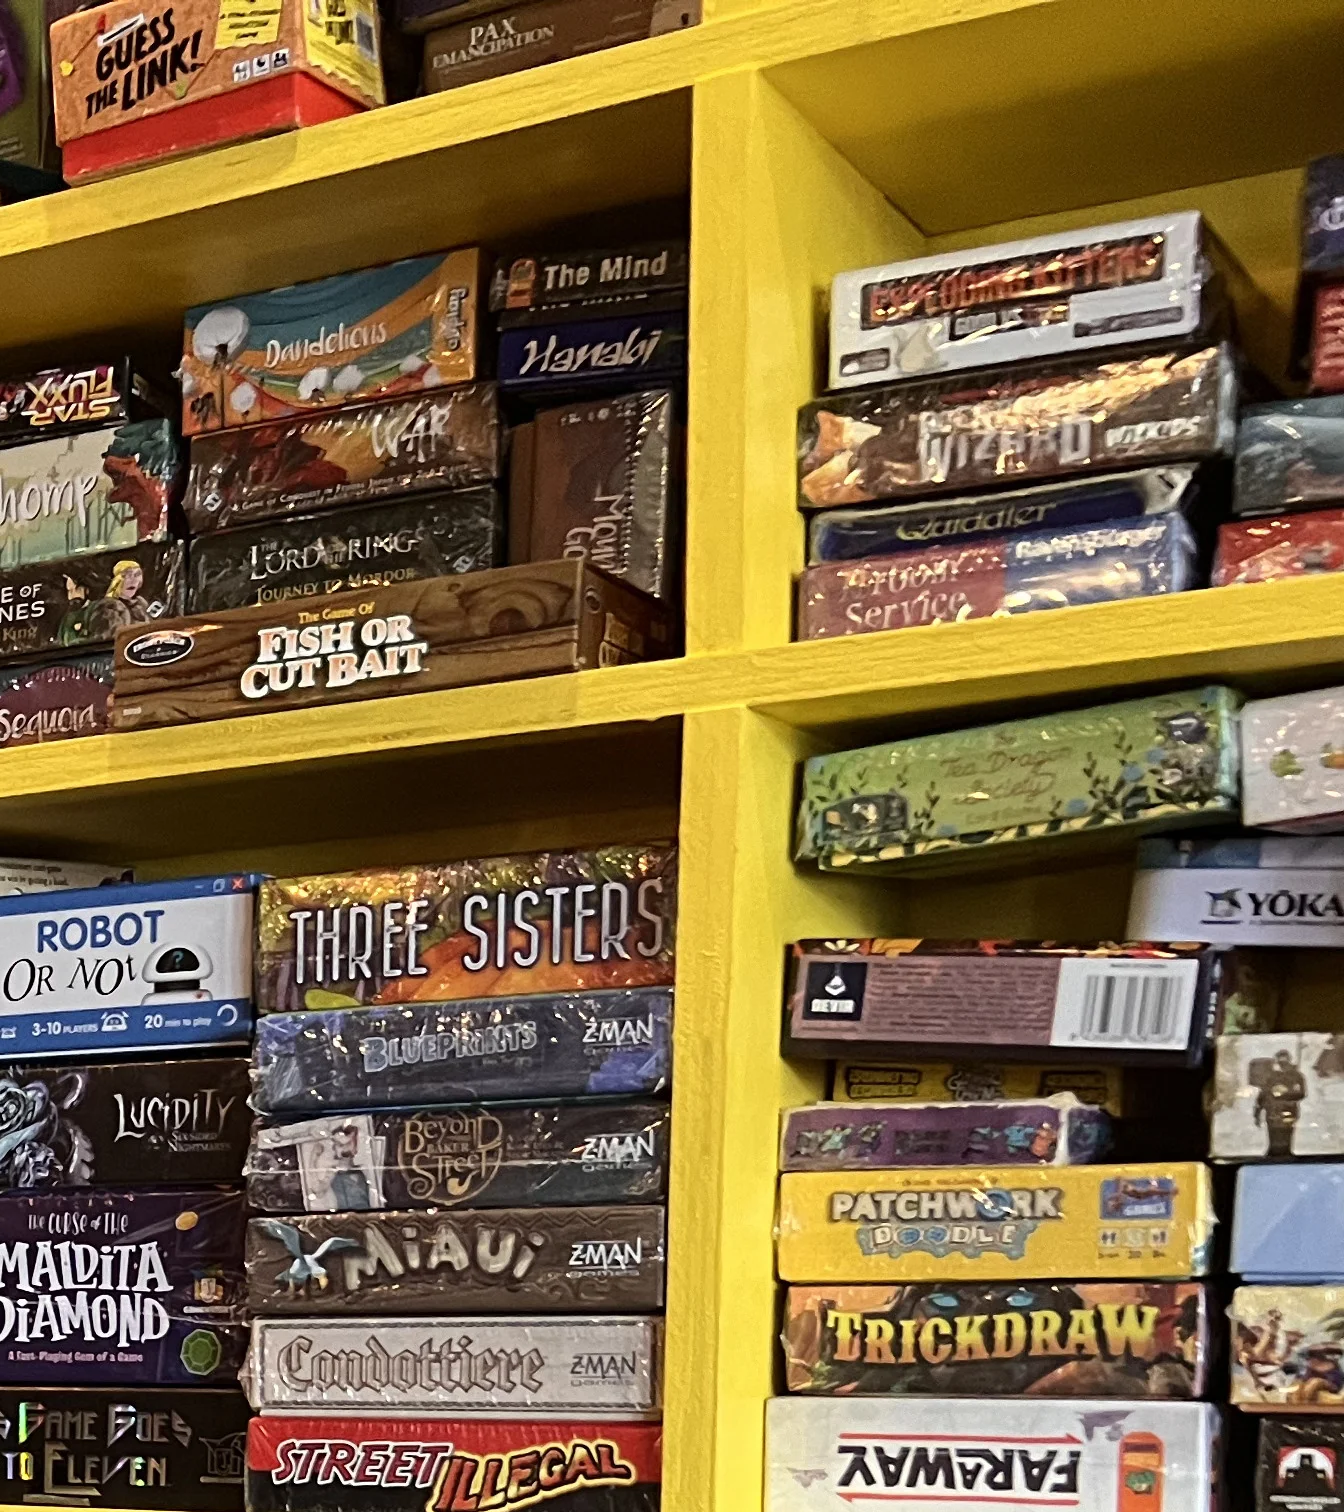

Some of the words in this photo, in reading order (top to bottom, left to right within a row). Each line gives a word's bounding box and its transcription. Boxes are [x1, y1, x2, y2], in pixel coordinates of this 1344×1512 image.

[95, 8, 176, 81] GUESS
[470, 18, 516, 46] PAX
[86, 83, 117, 119] THE
[120, 31, 205, 110] LINK!
[545, 263, 590, 291] The
[599, 250, 666, 283] Mind
[519, 327, 663, 376] Hanabi
[18, 582, 41, 599] OF
[255, 619, 353, 663] FISH
[360, 614, 414, 646] OR
[240, 650, 320, 700] CUT
[326, 640, 428, 690] BAIT
[37, 909, 165, 953] ROBOT
[289, 898, 430, 985] THREE
[462, 876, 666, 974] SISTERS
[830, 1187, 1064, 1221] PATCHWORK
[872, 1223, 1016, 1247] DOODLE
[826, 1302, 1160, 1364] TRICKDRAW
[277, 1335, 546, 1394] Condottiere
[272, 1438, 453, 1488] STREET
[835, 1444, 1082, 1494] FARAWAY
